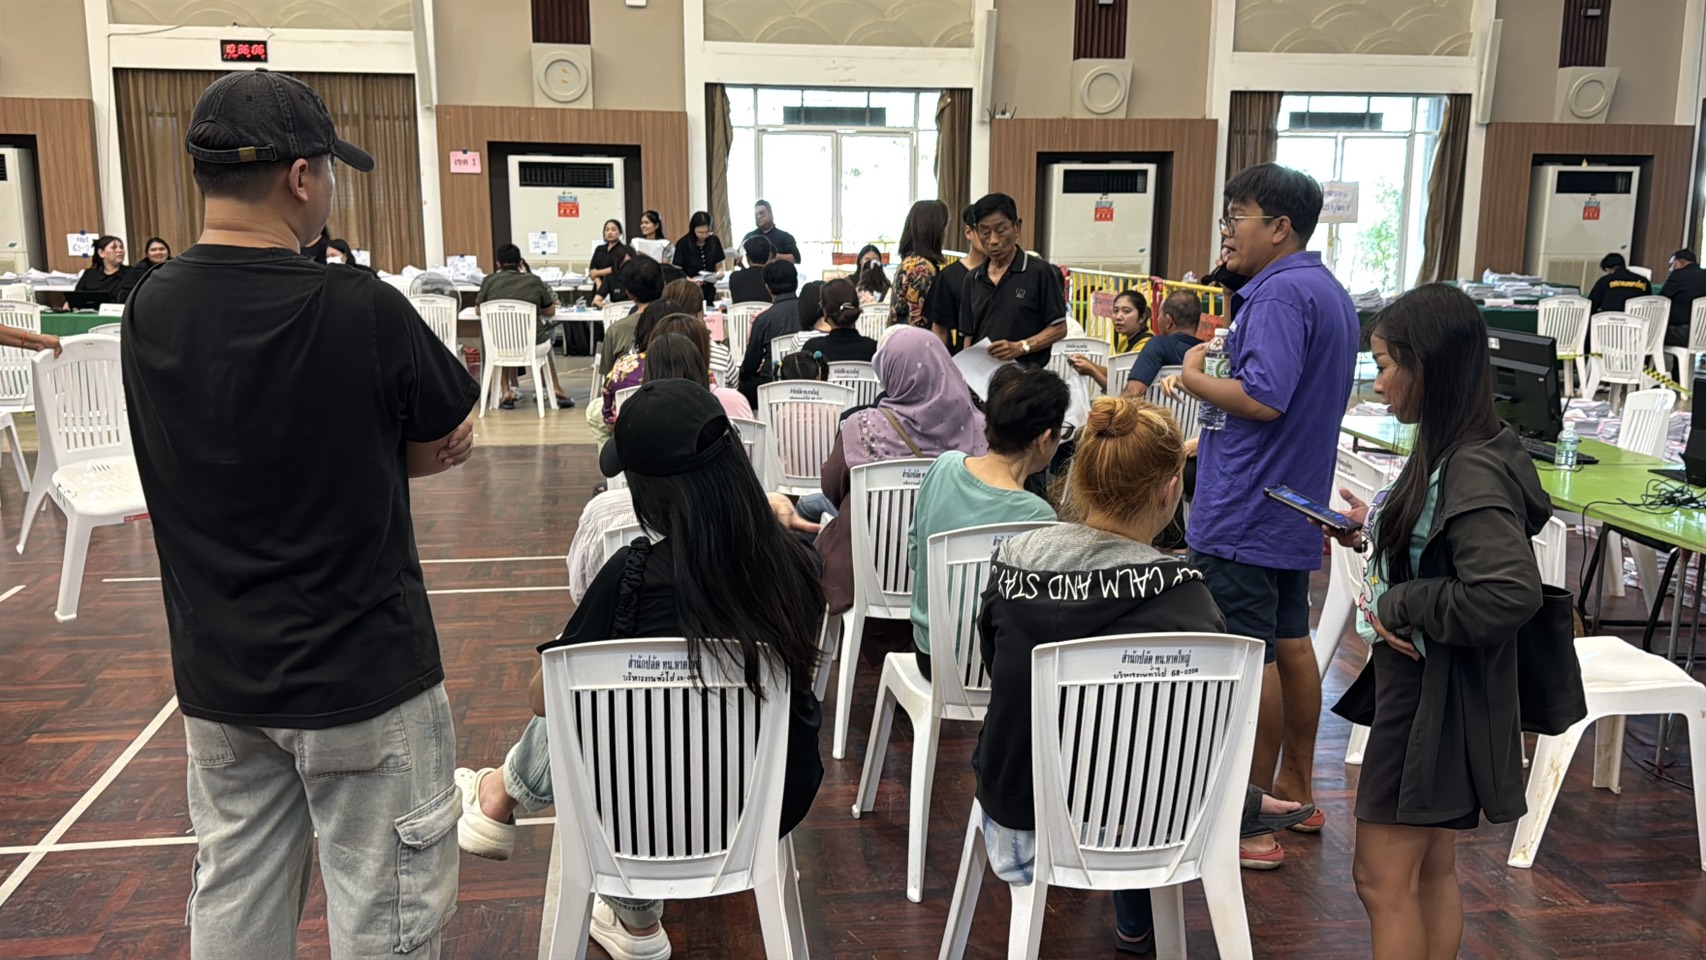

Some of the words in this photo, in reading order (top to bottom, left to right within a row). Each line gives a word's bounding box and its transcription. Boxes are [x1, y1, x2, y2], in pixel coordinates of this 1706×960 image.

[998, 569, 1041, 600] STAY
[1048, 571, 1093, 600] AND
[1100, 566, 1164, 598] CALM
[628, 654, 660, 670] สำนักปลัด
[1121, 649, 1153, 665] สำนักปลัด
[1154, 649, 1192, 667] ทน.หาดใหญ่
[623, 671, 675, 682] บริหารงานทั่วไป
[1113, 665, 1167, 679] บริหารงานทั่วไป
